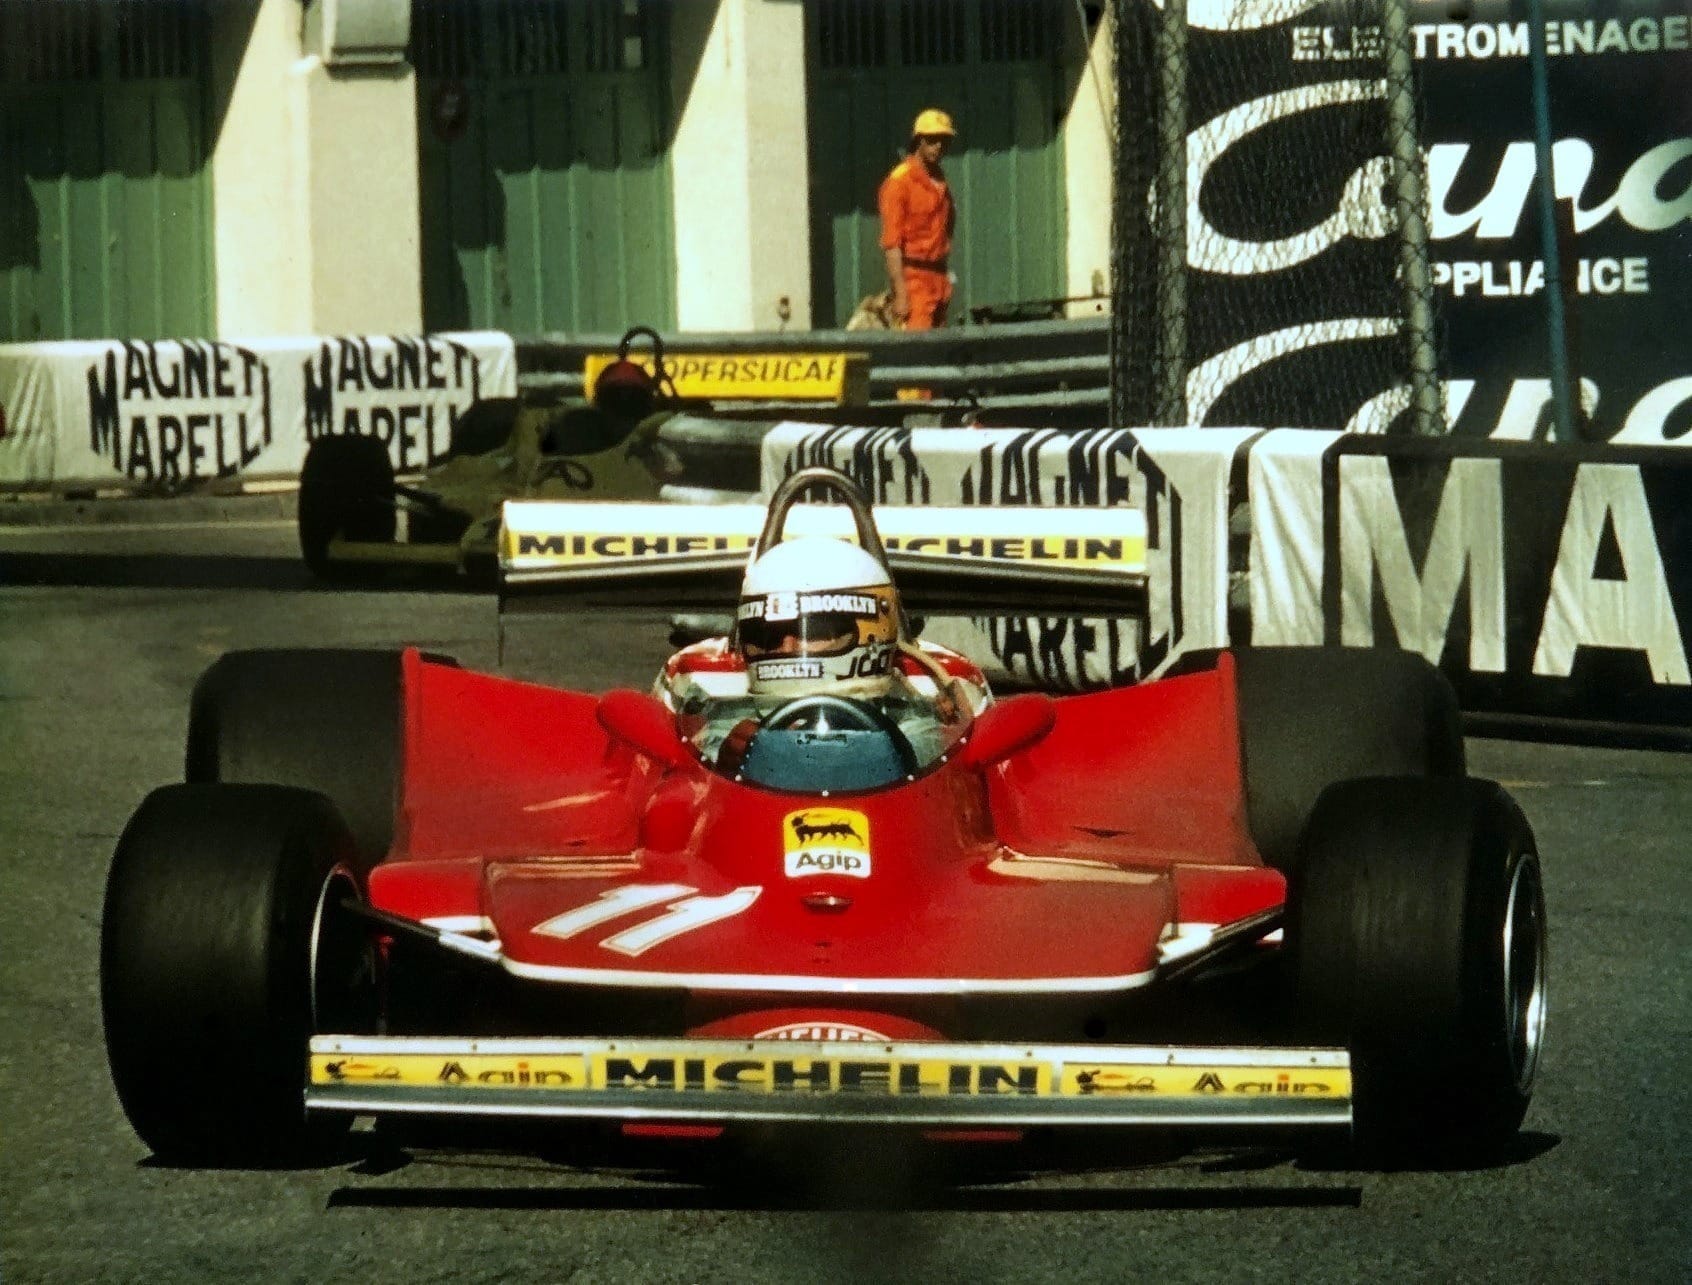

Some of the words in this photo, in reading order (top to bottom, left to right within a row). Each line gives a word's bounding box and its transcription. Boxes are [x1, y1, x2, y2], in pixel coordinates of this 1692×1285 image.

[885, 536, 1124, 560] ICHELIN
[800, 594, 877, 615] BROOKLYN
[757, 663, 821, 679] BROOKLYN
[795, 850, 863, 872] Agip
[530, 883, 763, 957] 11
[605, 1058, 1039, 1095] MICHELIN
